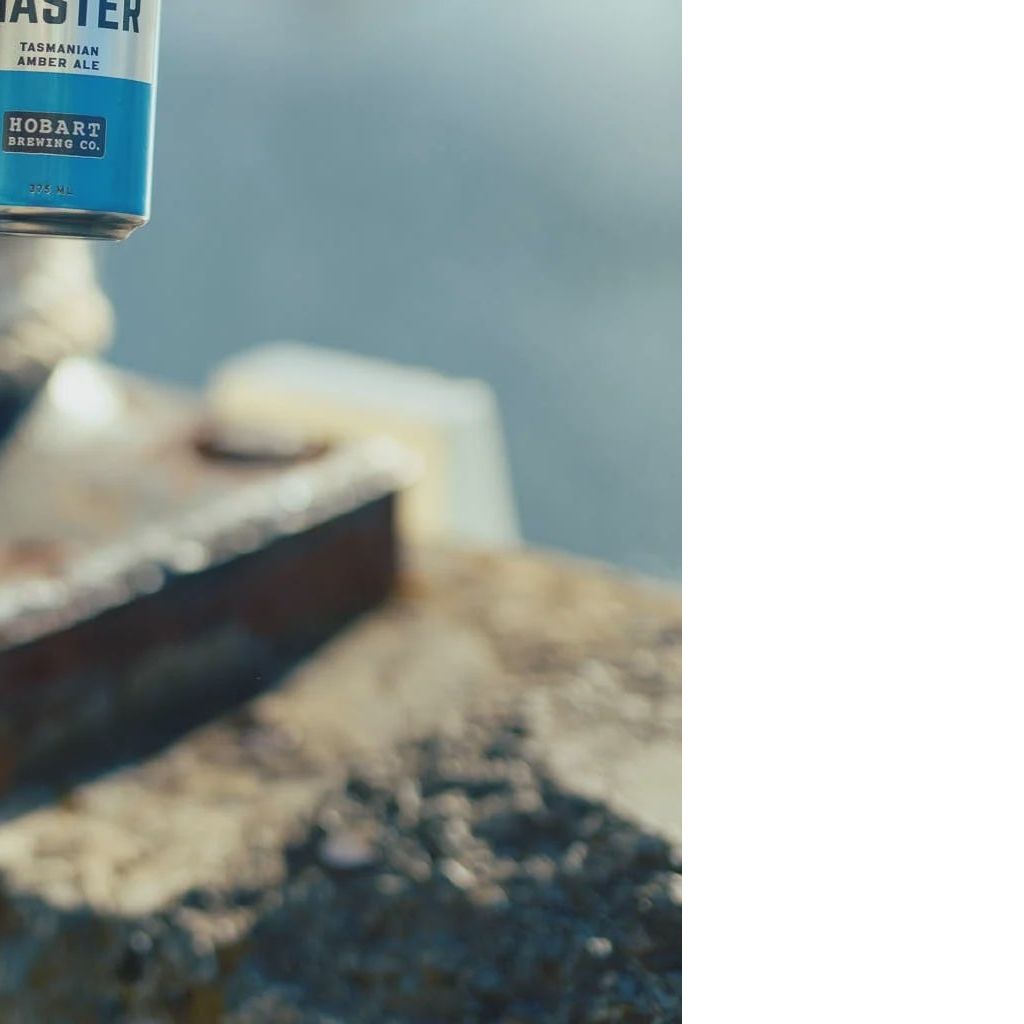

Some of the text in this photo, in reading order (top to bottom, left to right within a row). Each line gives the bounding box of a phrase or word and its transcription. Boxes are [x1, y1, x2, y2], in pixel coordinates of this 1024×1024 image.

[19, 41, 99, 57] TASMANIAN
[17, 56, 100, 71] AMBER ALE
[9, 117, 101, 138] HOBART
[8, 137, 101, 151] BREWING CO.
